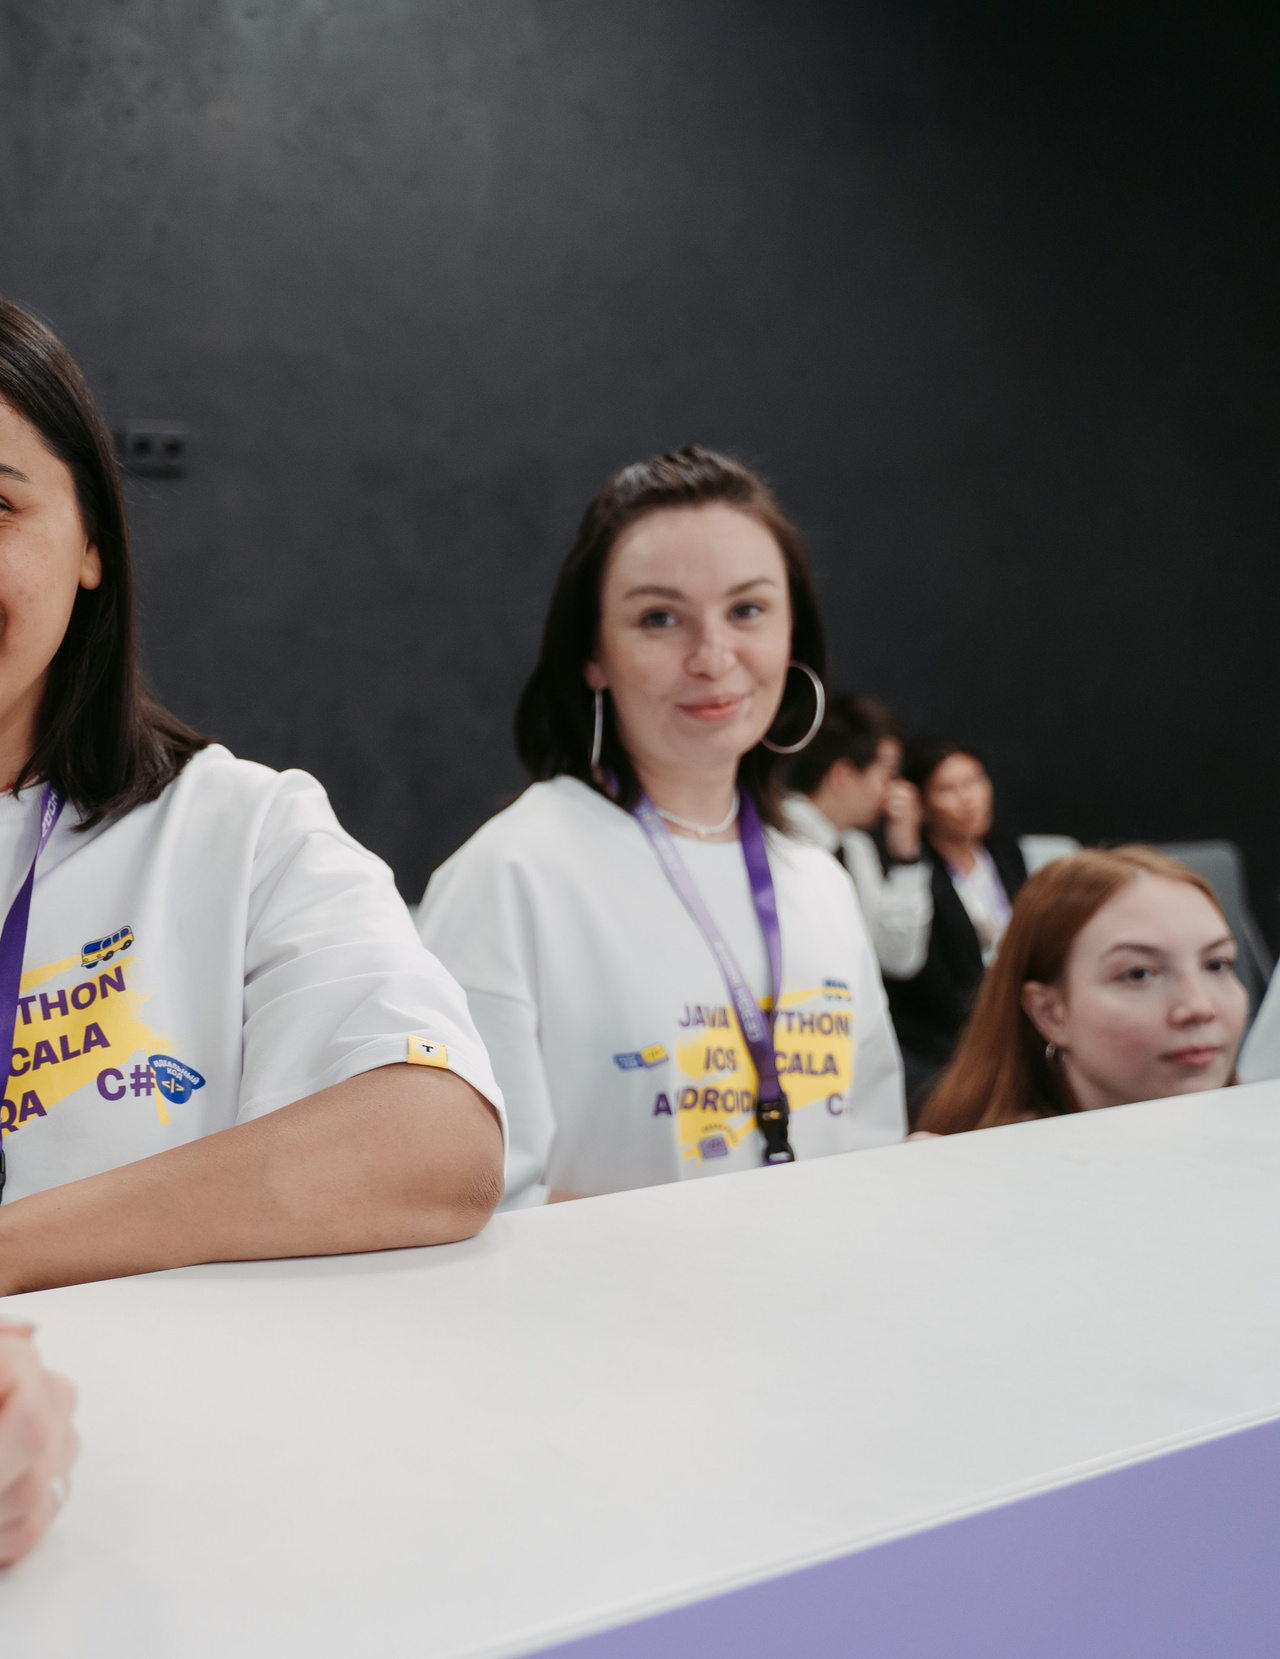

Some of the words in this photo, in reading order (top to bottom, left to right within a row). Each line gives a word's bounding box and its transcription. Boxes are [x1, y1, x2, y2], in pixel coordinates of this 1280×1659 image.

[679, 1003, 730, 1028] JAVA
[8, 1021, 111, 1077] CALA
[704, 1048, 737, 1072] IOS
[775, 1050, 838, 1076] CALA
[96, 1064, 155, 1102] C#
[166, 1067, 183, 1081] КОД
[653, 1082, 754, 1117] ADROID
